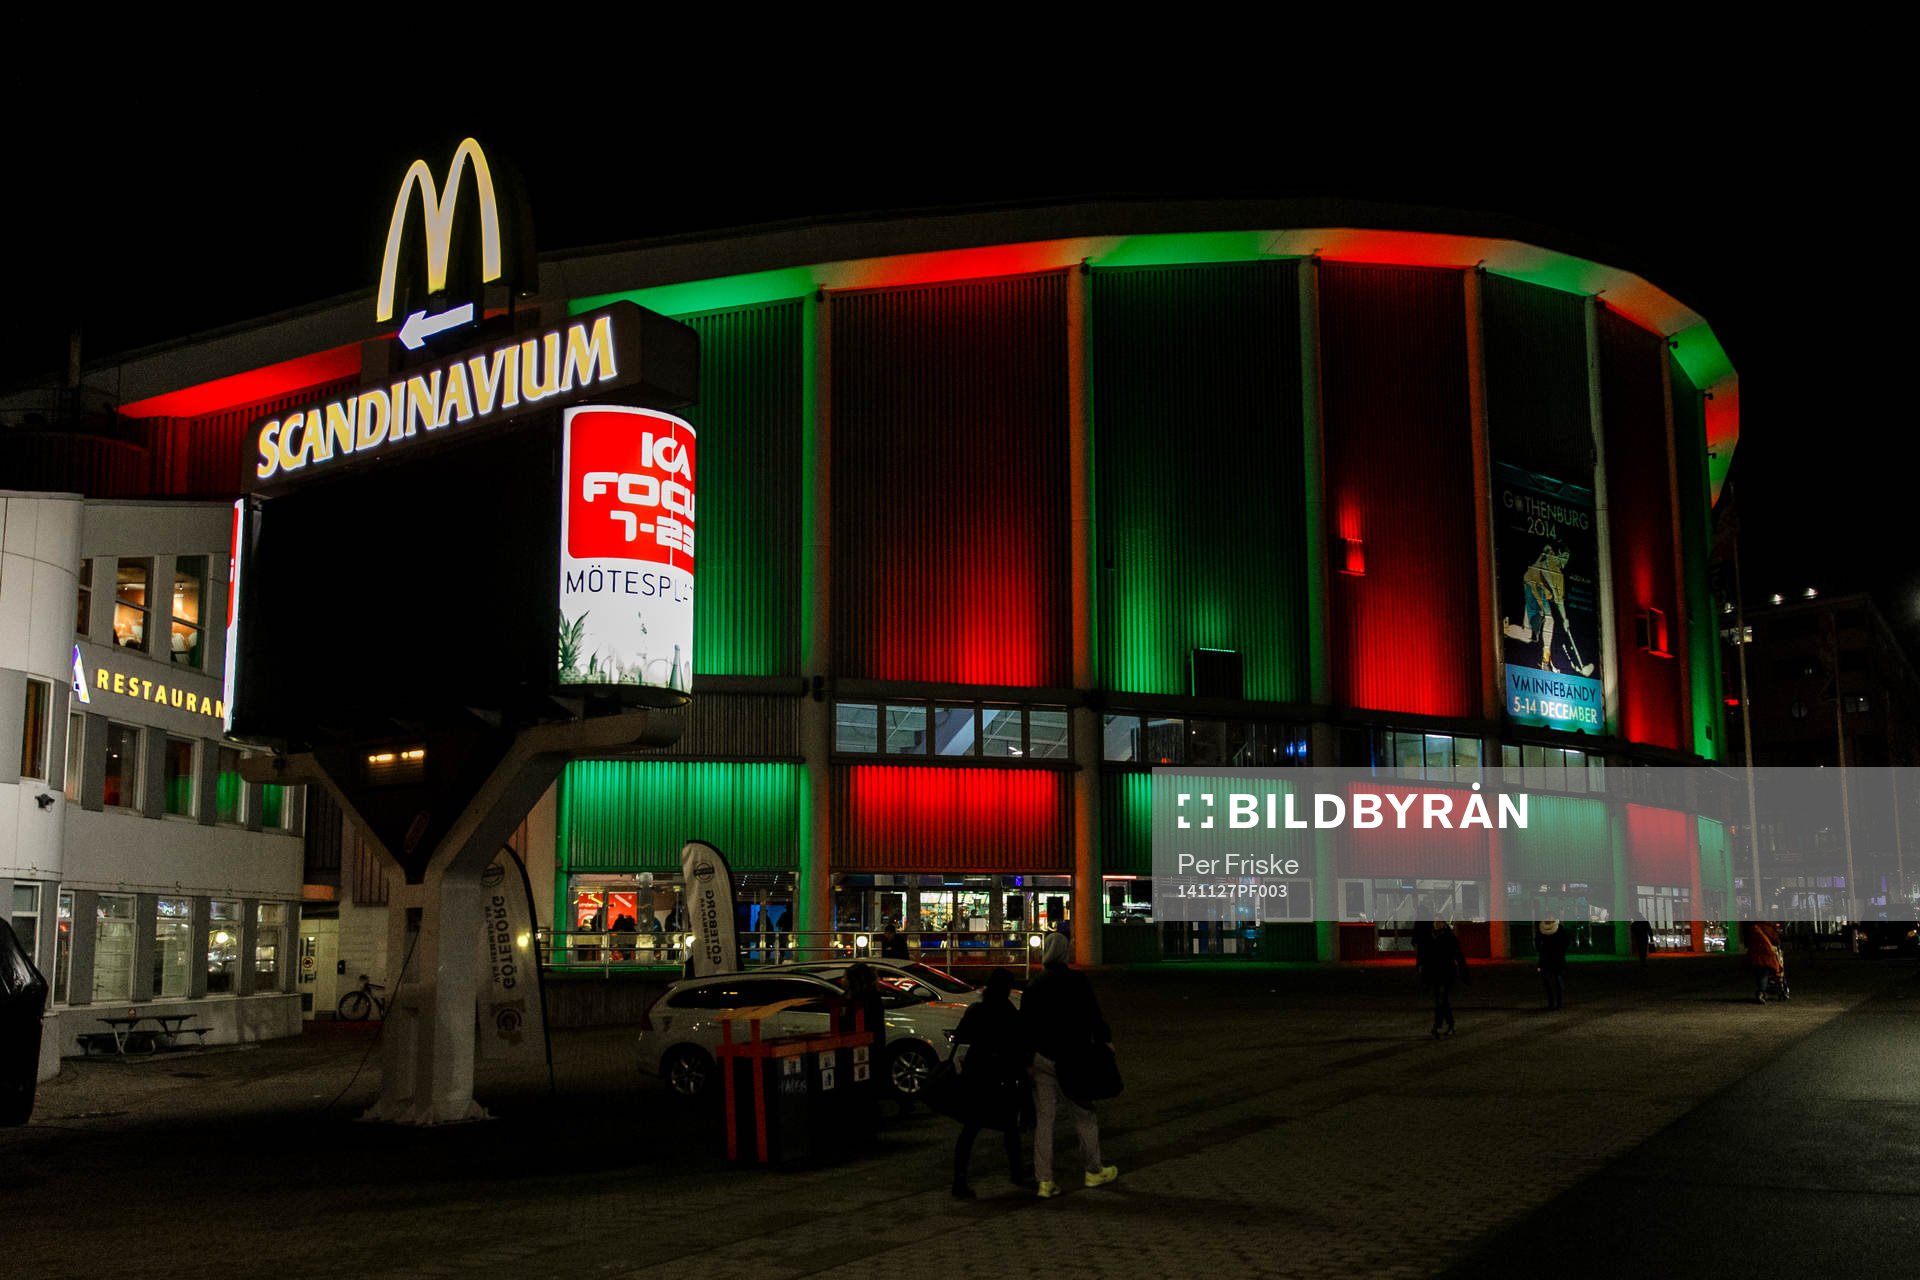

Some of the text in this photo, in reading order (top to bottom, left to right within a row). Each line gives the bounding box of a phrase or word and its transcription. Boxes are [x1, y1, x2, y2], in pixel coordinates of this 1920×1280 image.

[257, 316, 618, 478] SCANDINAVIUM
[640, 431, 692, 482] ICA
[1503, 490, 1590, 532] GOTHENBURG
[1526, 517, 1557, 540] 2014
[609, 510, 694, 558] 7-23
[97, 668, 225, 719] RESTAURAN
[1513, 674, 1597, 701] VM INNEBANDY
[1513, 696, 1599, 725] 5-14 DECEMBER
